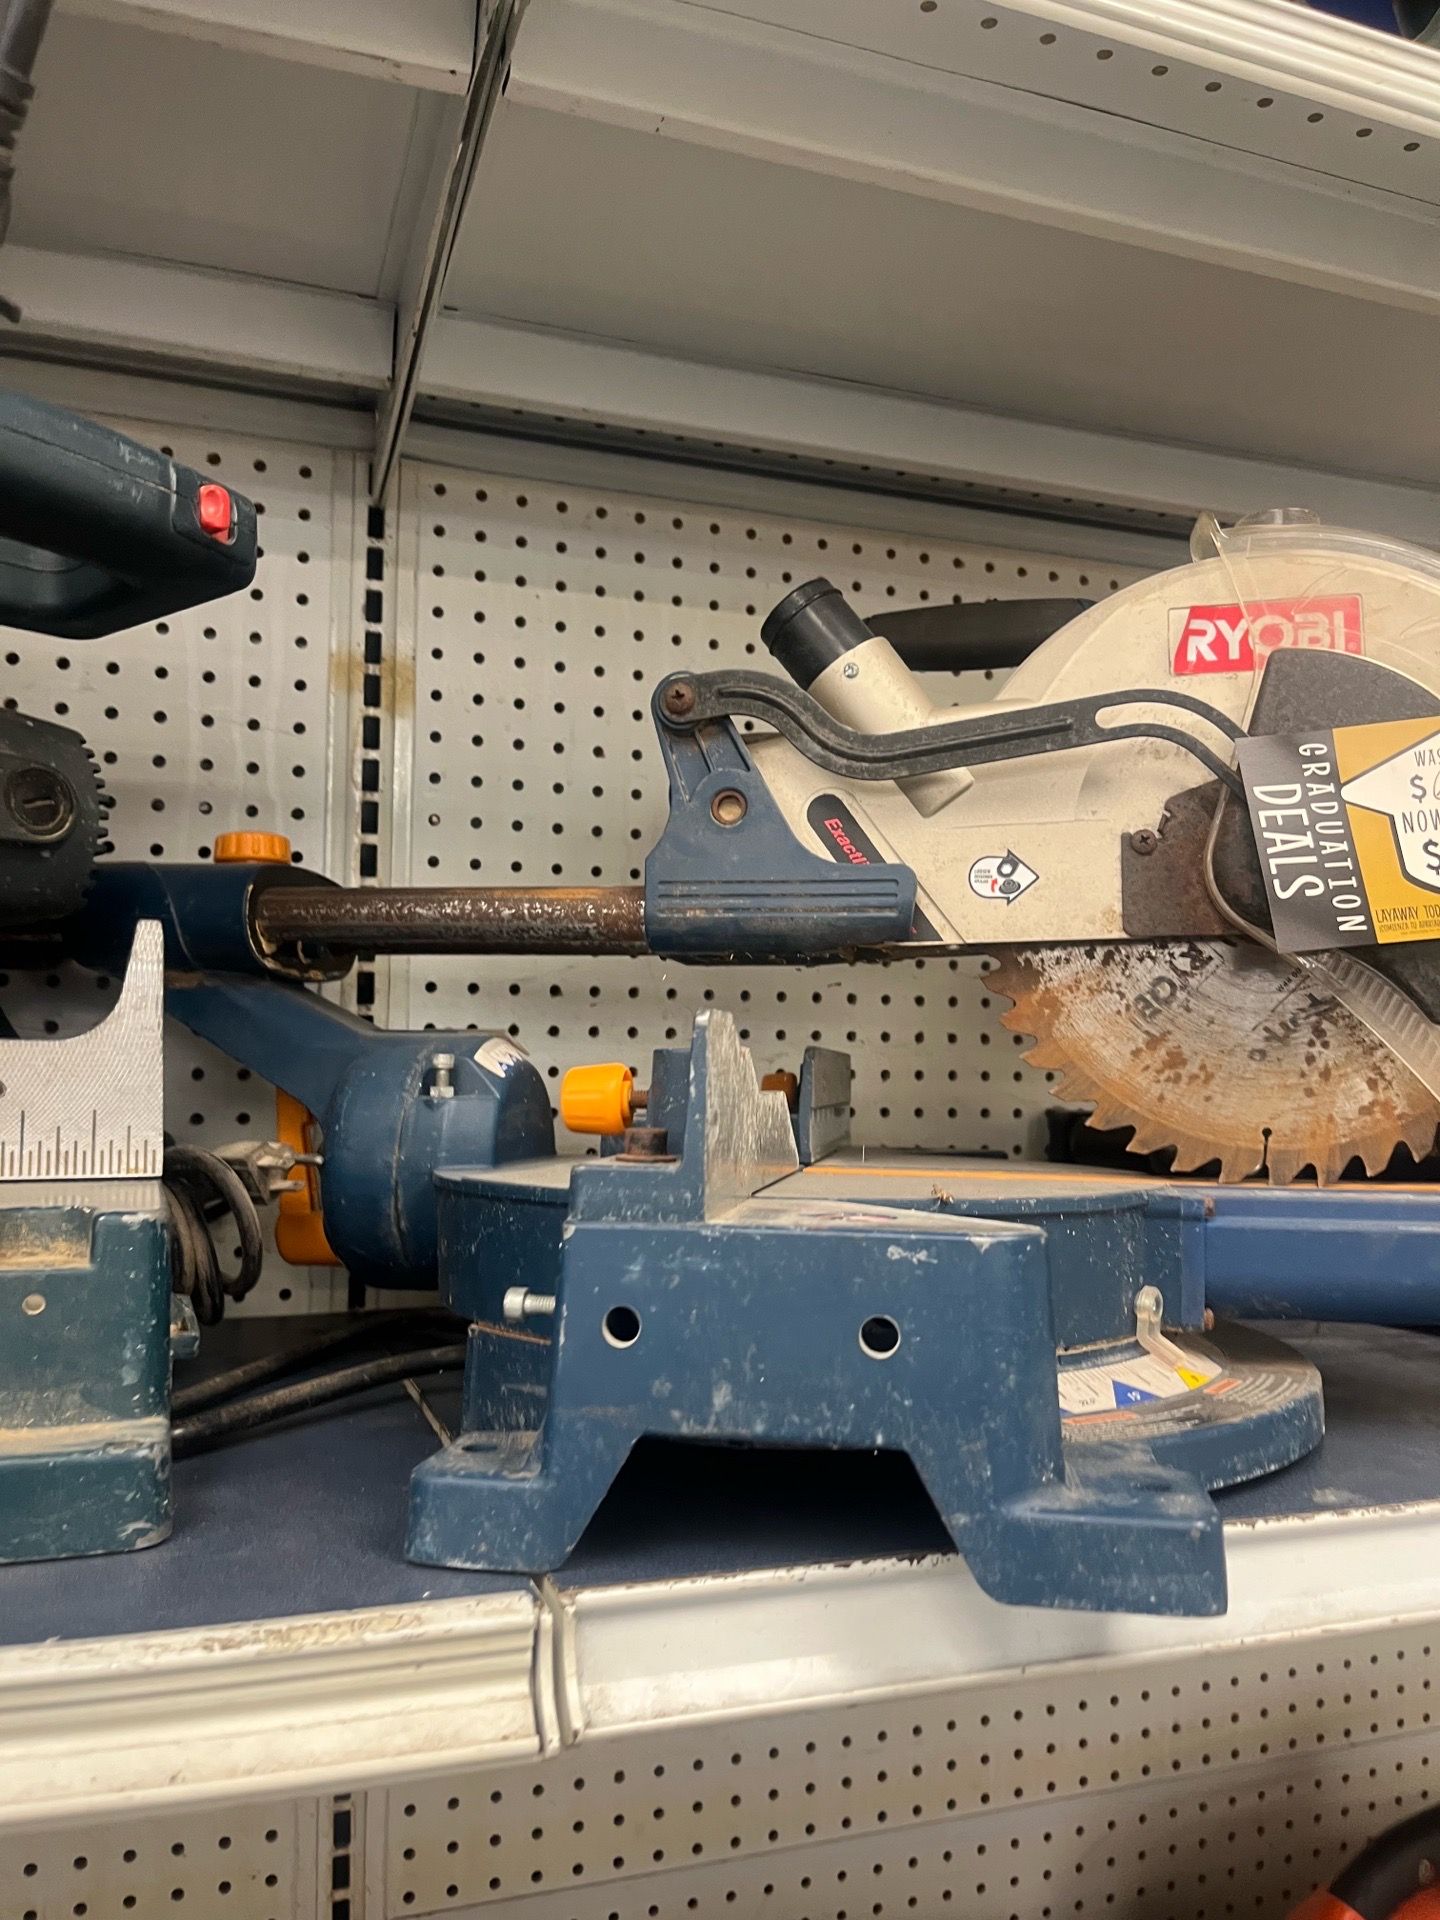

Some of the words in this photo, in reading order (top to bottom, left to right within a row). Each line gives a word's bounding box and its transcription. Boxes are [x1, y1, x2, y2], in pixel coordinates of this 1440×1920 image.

[1186, 611, 1345, 662] RYOBI
[1253, 784, 1324, 900] DEALS
[1299, 743, 1367, 932] GRADUATION
[1375, 906, 1419, 923] LAYAWAY
